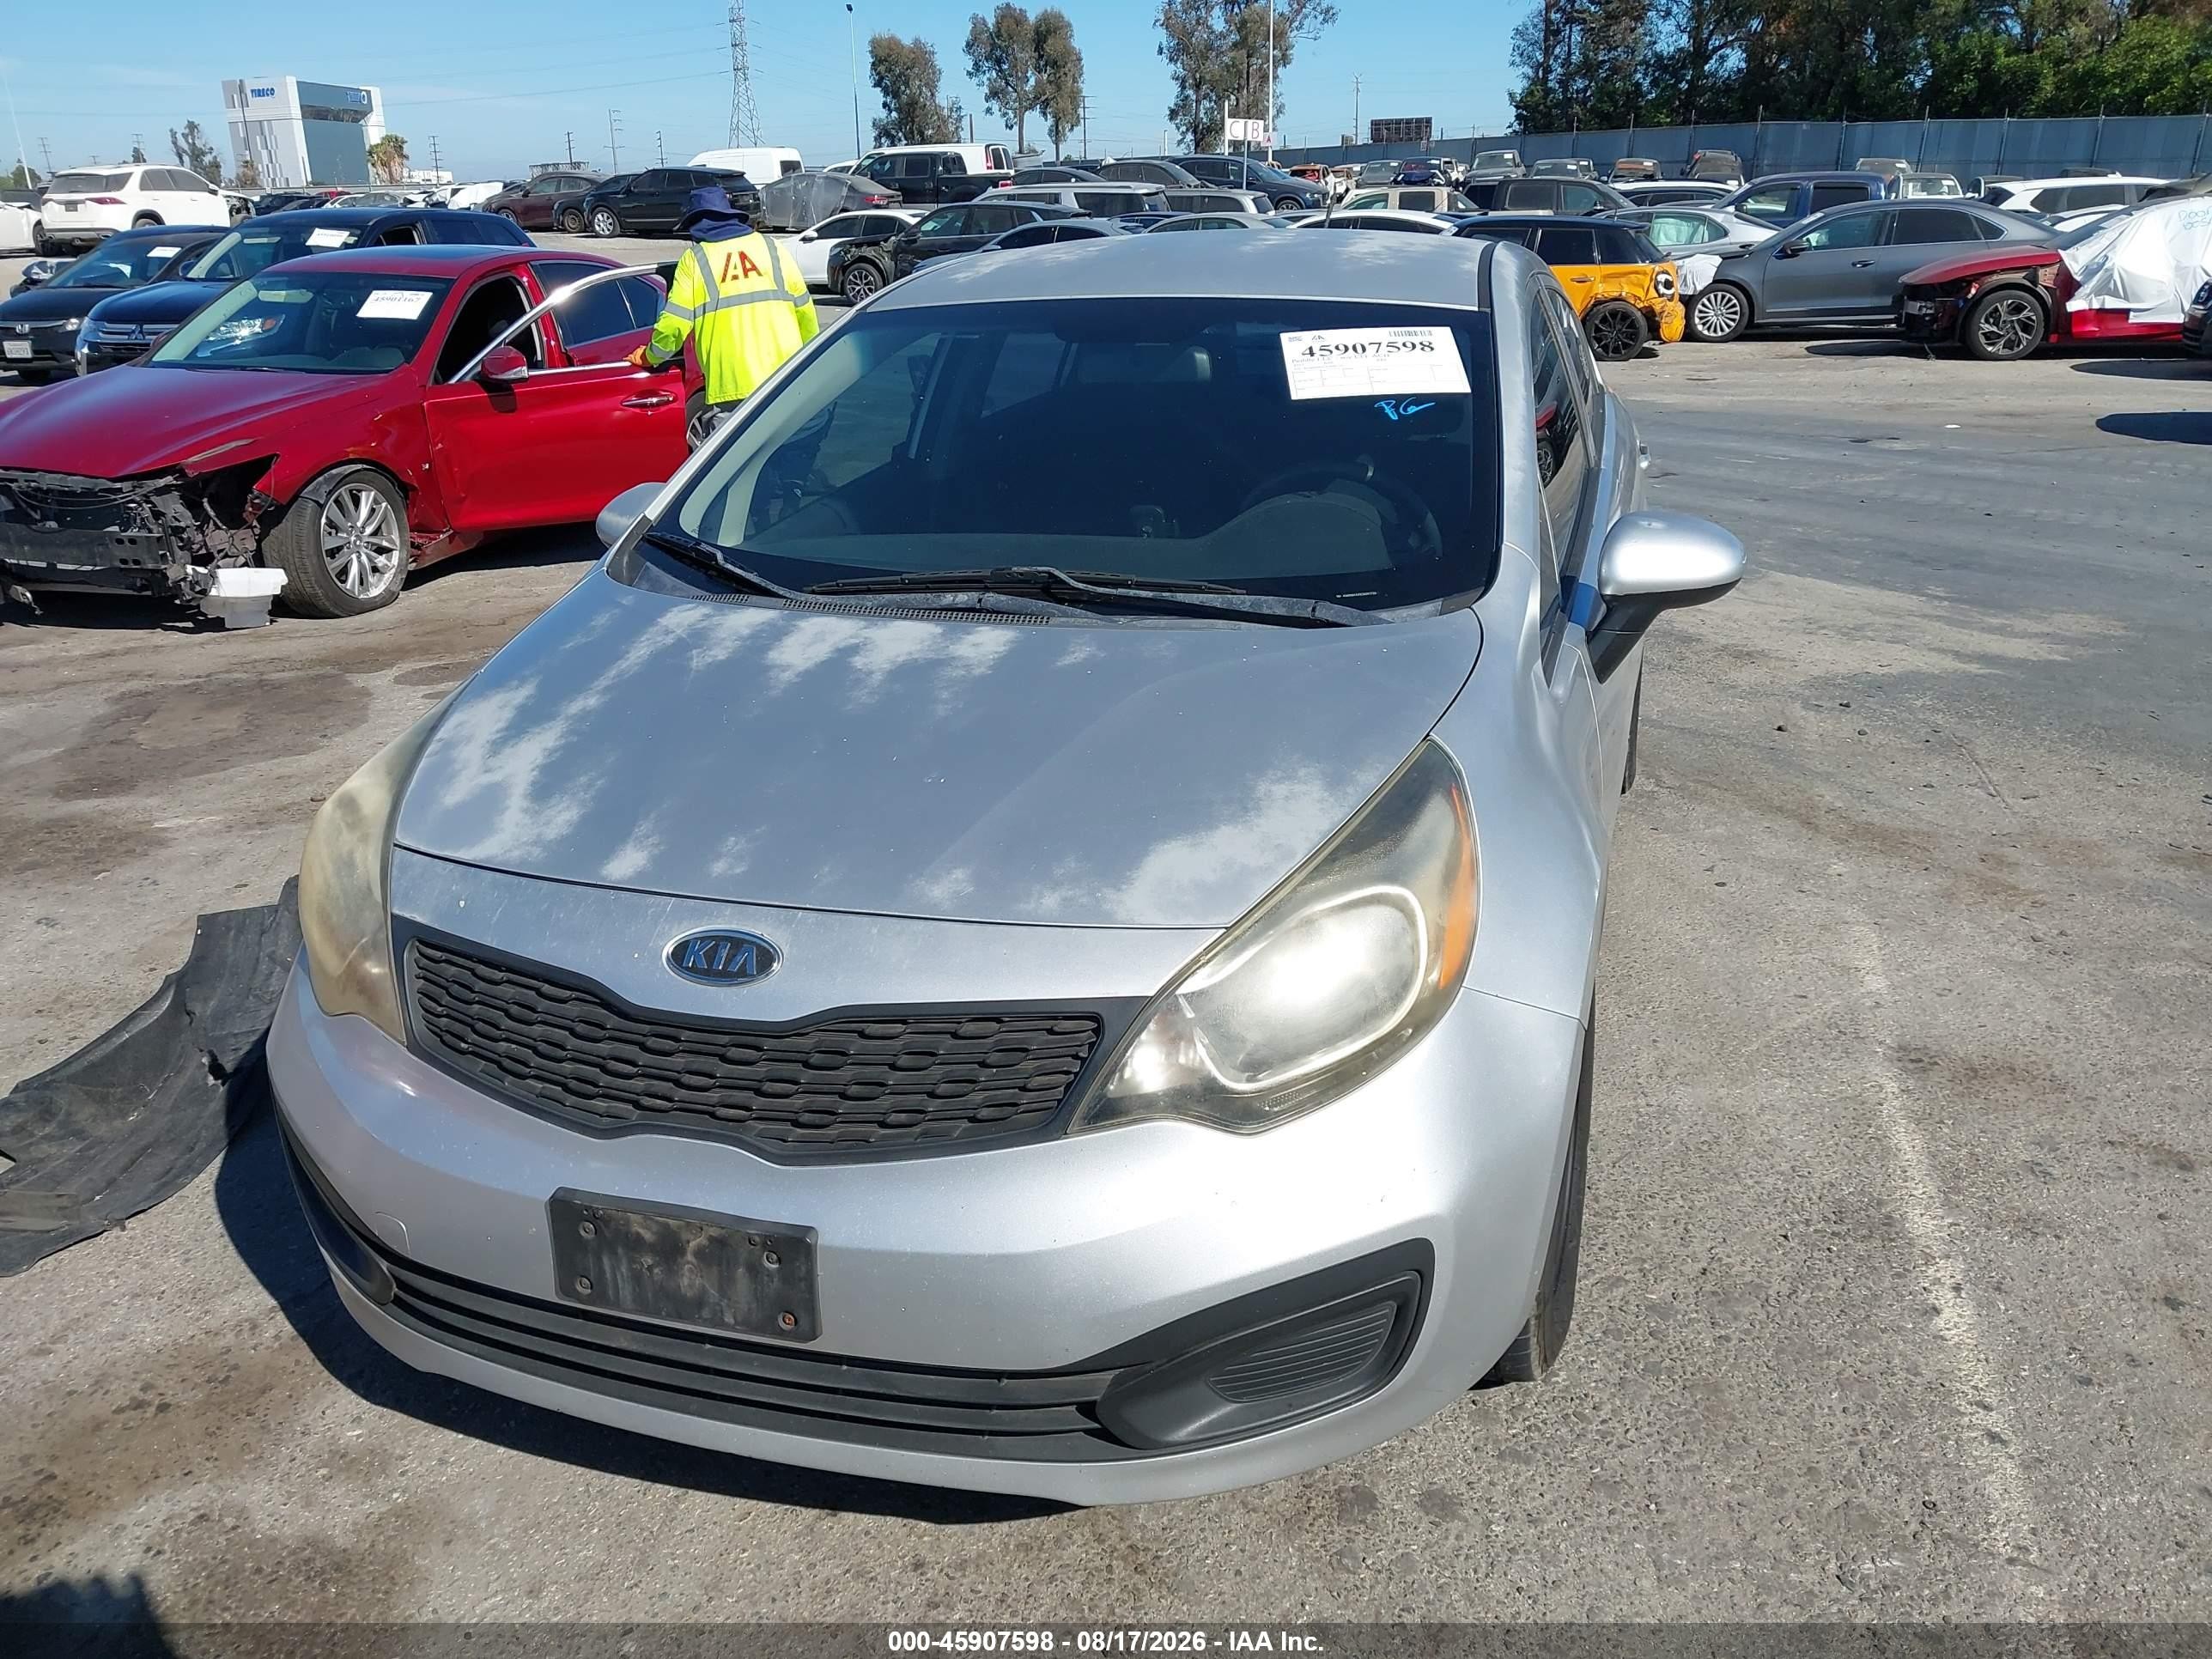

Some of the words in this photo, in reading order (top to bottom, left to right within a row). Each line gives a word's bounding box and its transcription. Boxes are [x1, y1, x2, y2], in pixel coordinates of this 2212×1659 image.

[1230, 120, 1240, 139] C
[1251, 121, 1260, 139] B
[1301, 341, 1435, 357] 45907598
[682, 939, 757, 976] KIA
